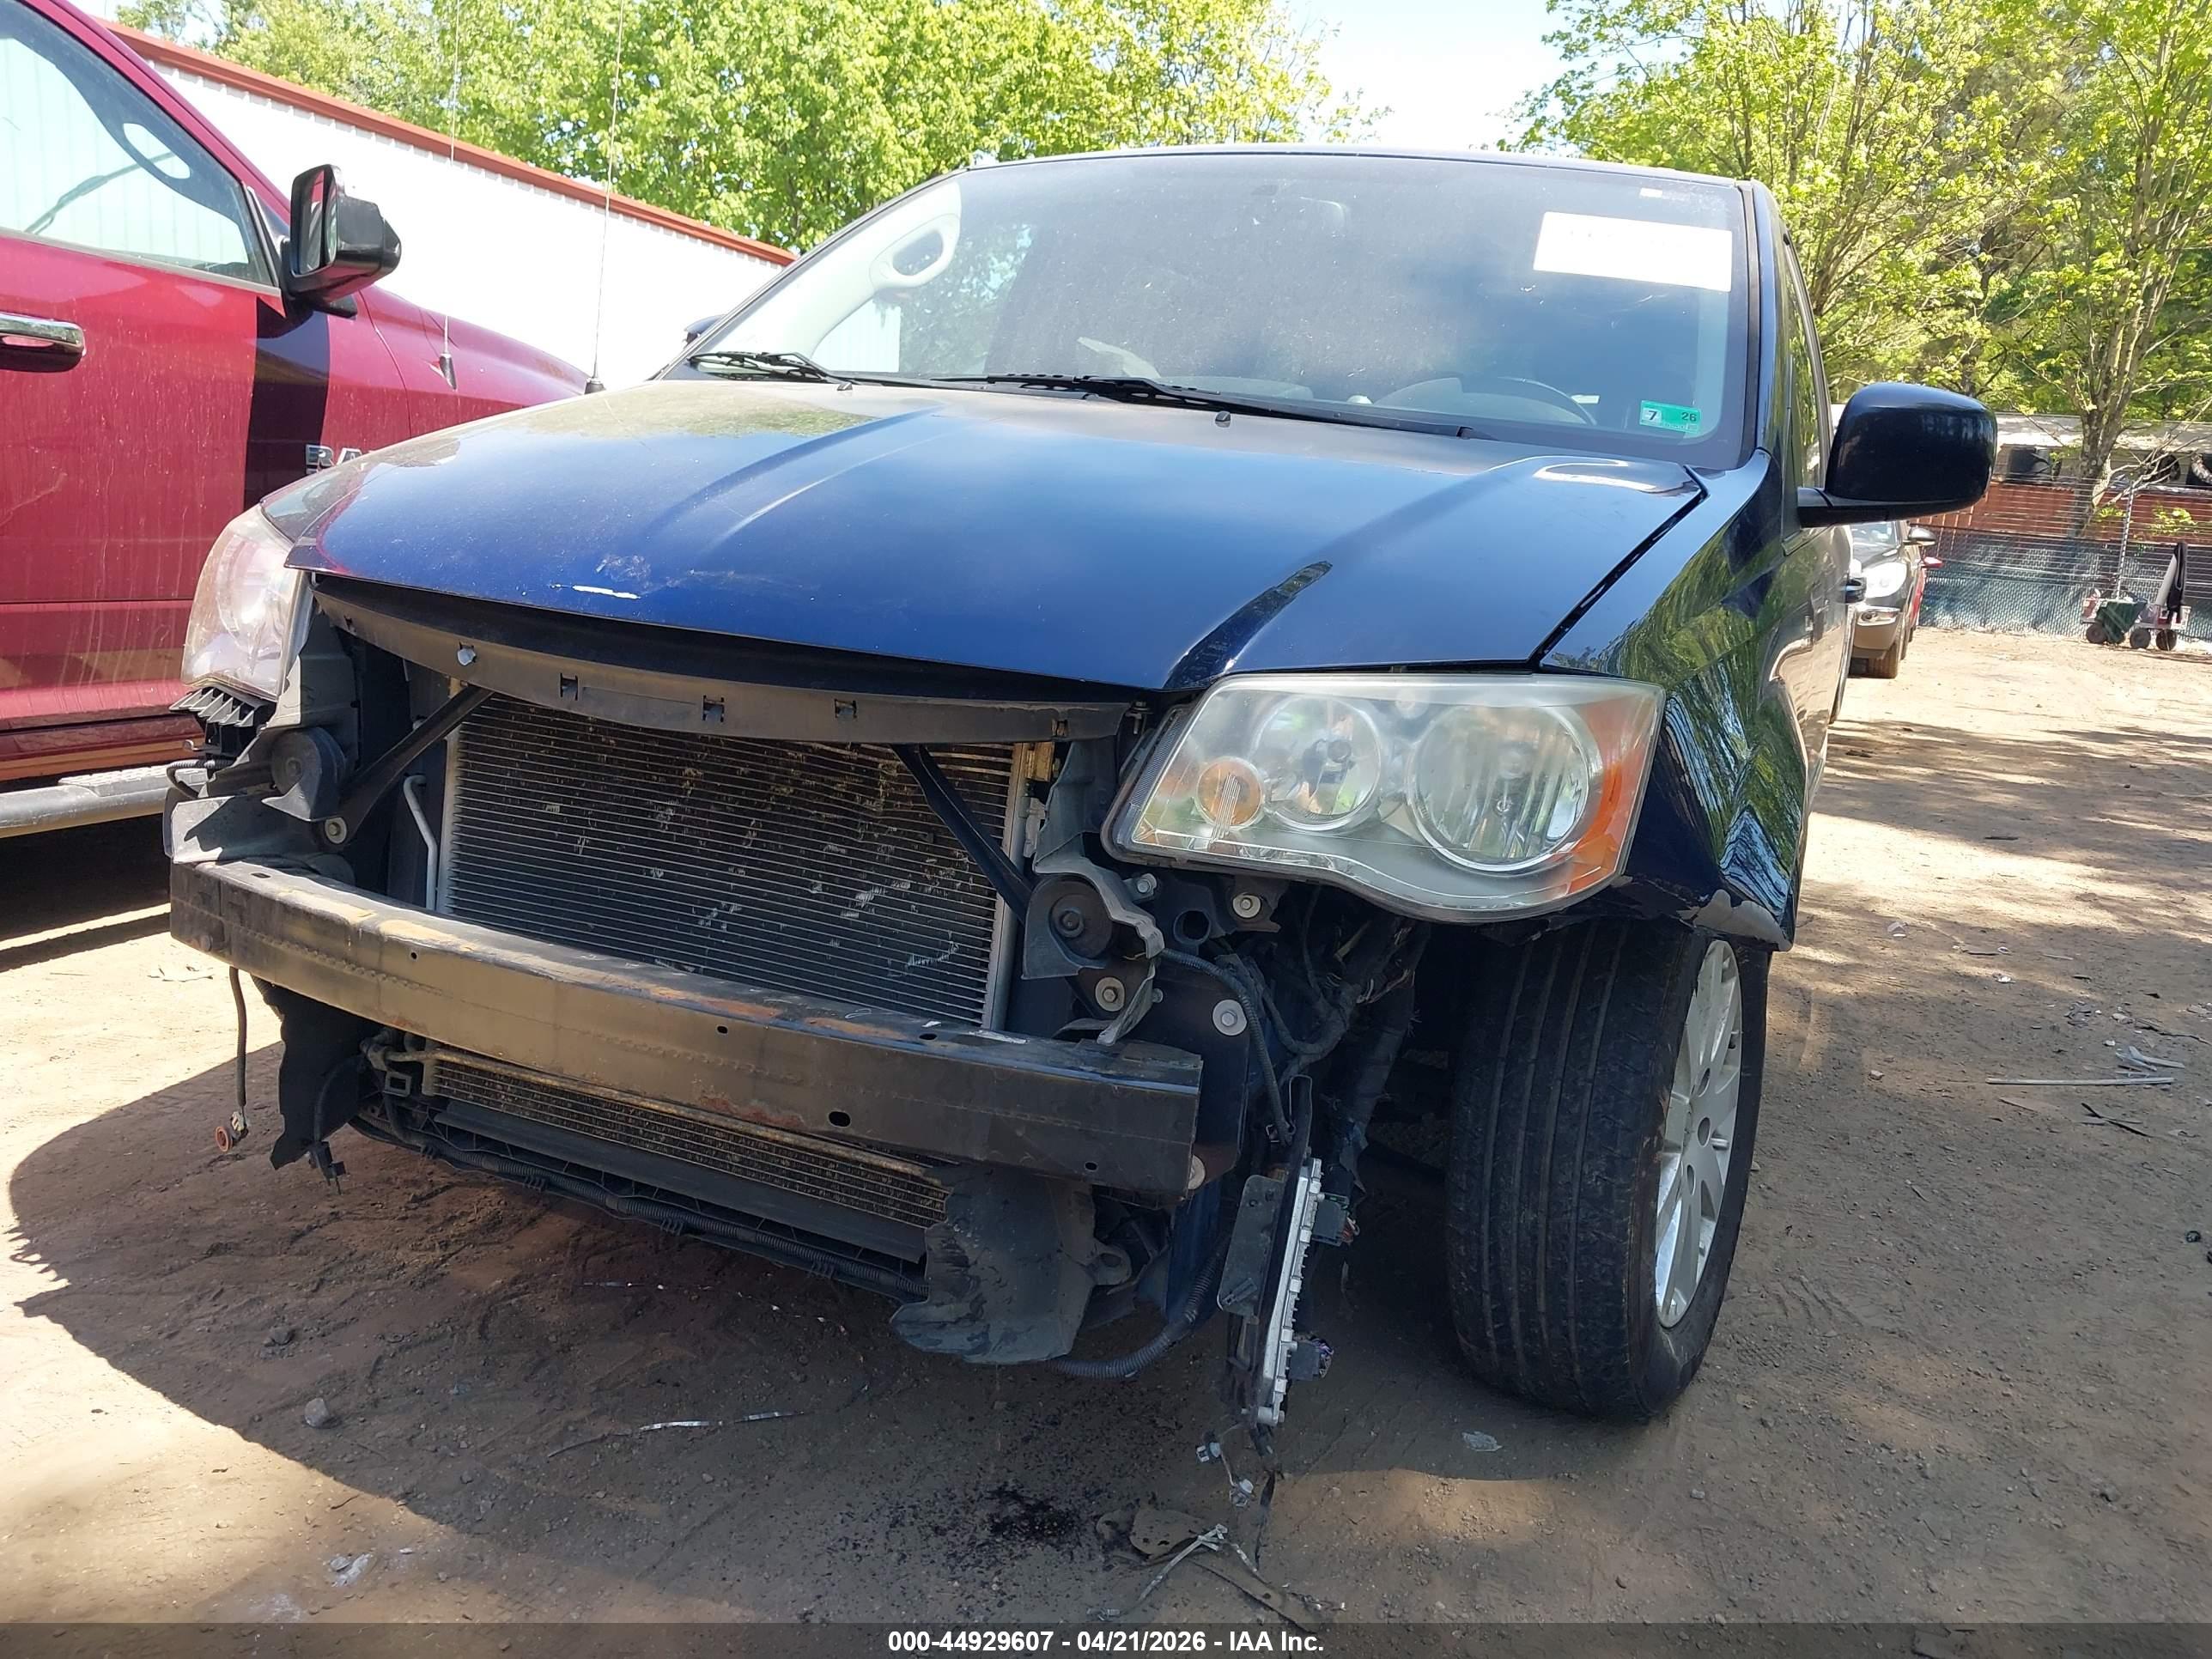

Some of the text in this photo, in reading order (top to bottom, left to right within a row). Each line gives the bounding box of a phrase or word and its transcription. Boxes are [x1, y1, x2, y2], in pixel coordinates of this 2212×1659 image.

[1648, 410, 1698, 422] 7 26
[306, 444, 373, 475] RA
